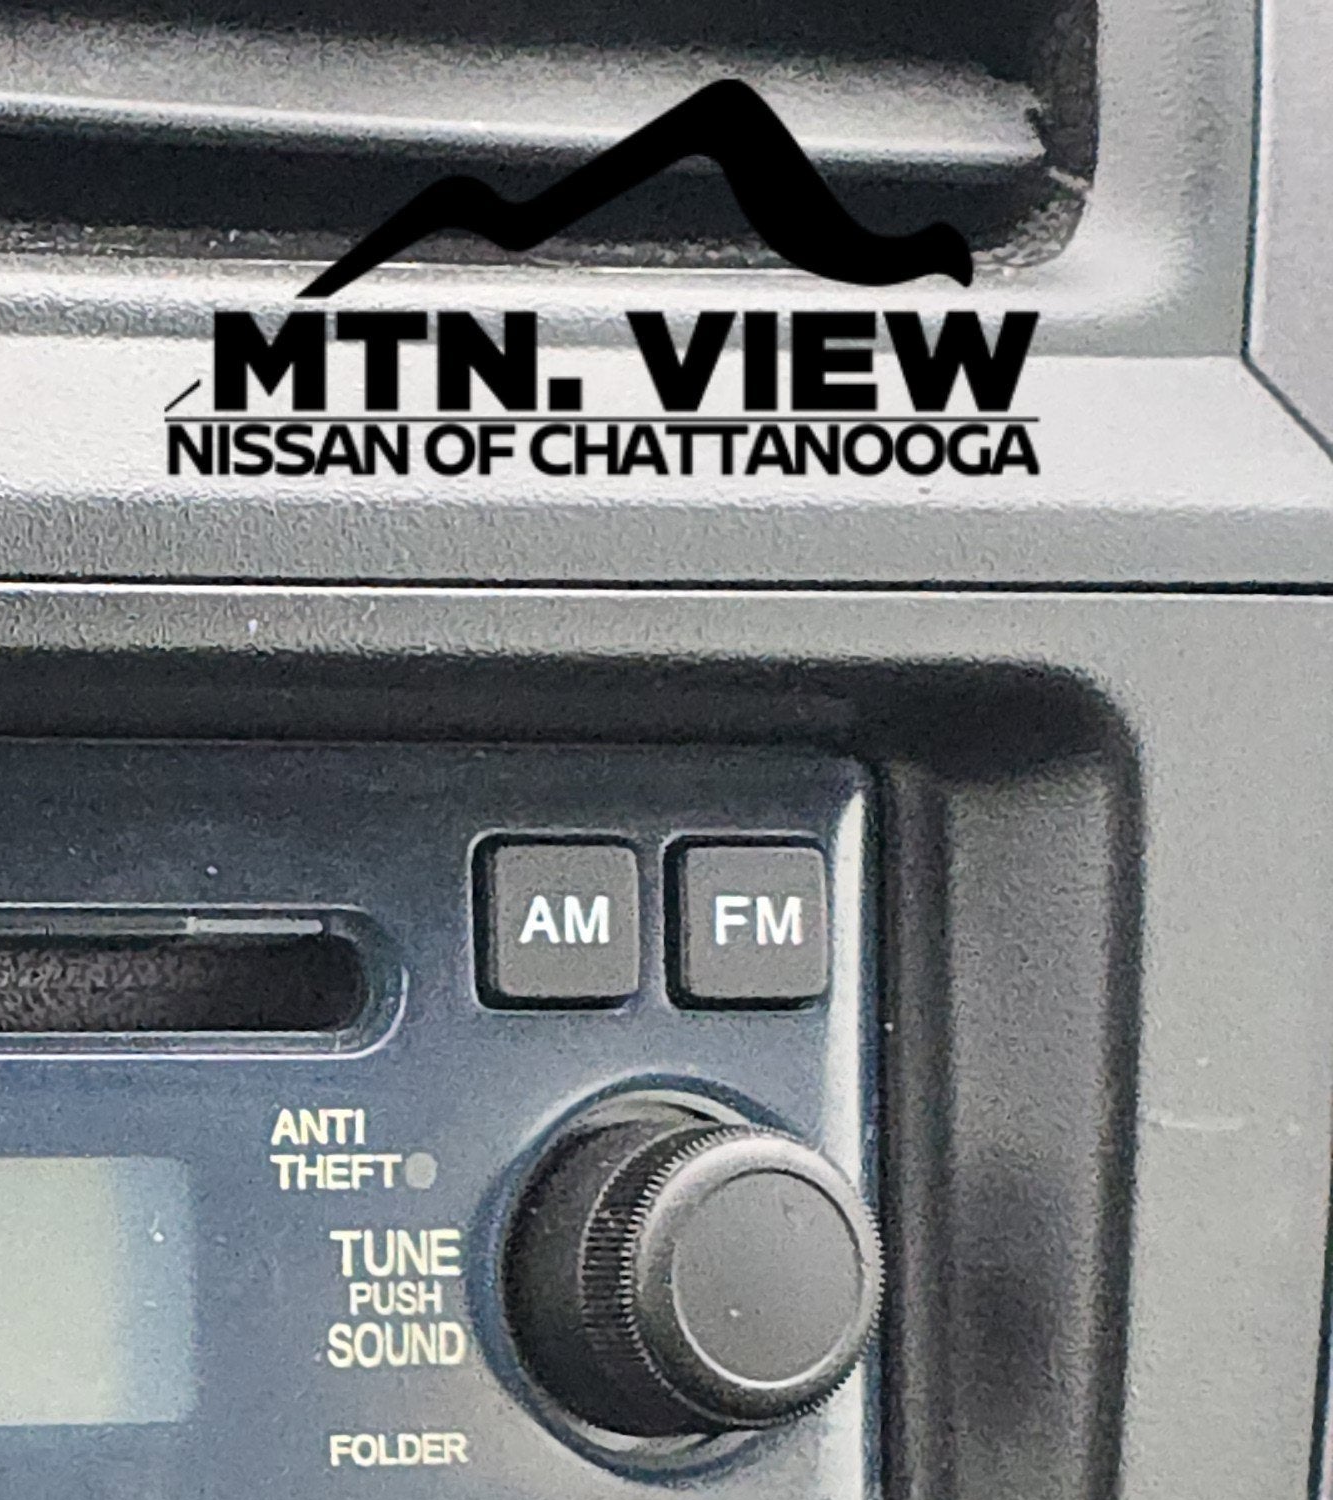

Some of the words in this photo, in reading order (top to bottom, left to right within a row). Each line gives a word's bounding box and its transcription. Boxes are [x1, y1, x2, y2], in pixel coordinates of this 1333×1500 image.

[518, 895, 610, 944] AM
[715, 895, 803, 946] FM
[270, 1108, 365, 1146] ANTI
[269, 1154, 403, 1190] THEFT
[329, 1228, 462, 1277] TUNE
[349, 1280, 442, 1316] PUSH
[327, 1321, 466, 1368] SOUND
[330, 1432, 469, 1467] FOLDER
